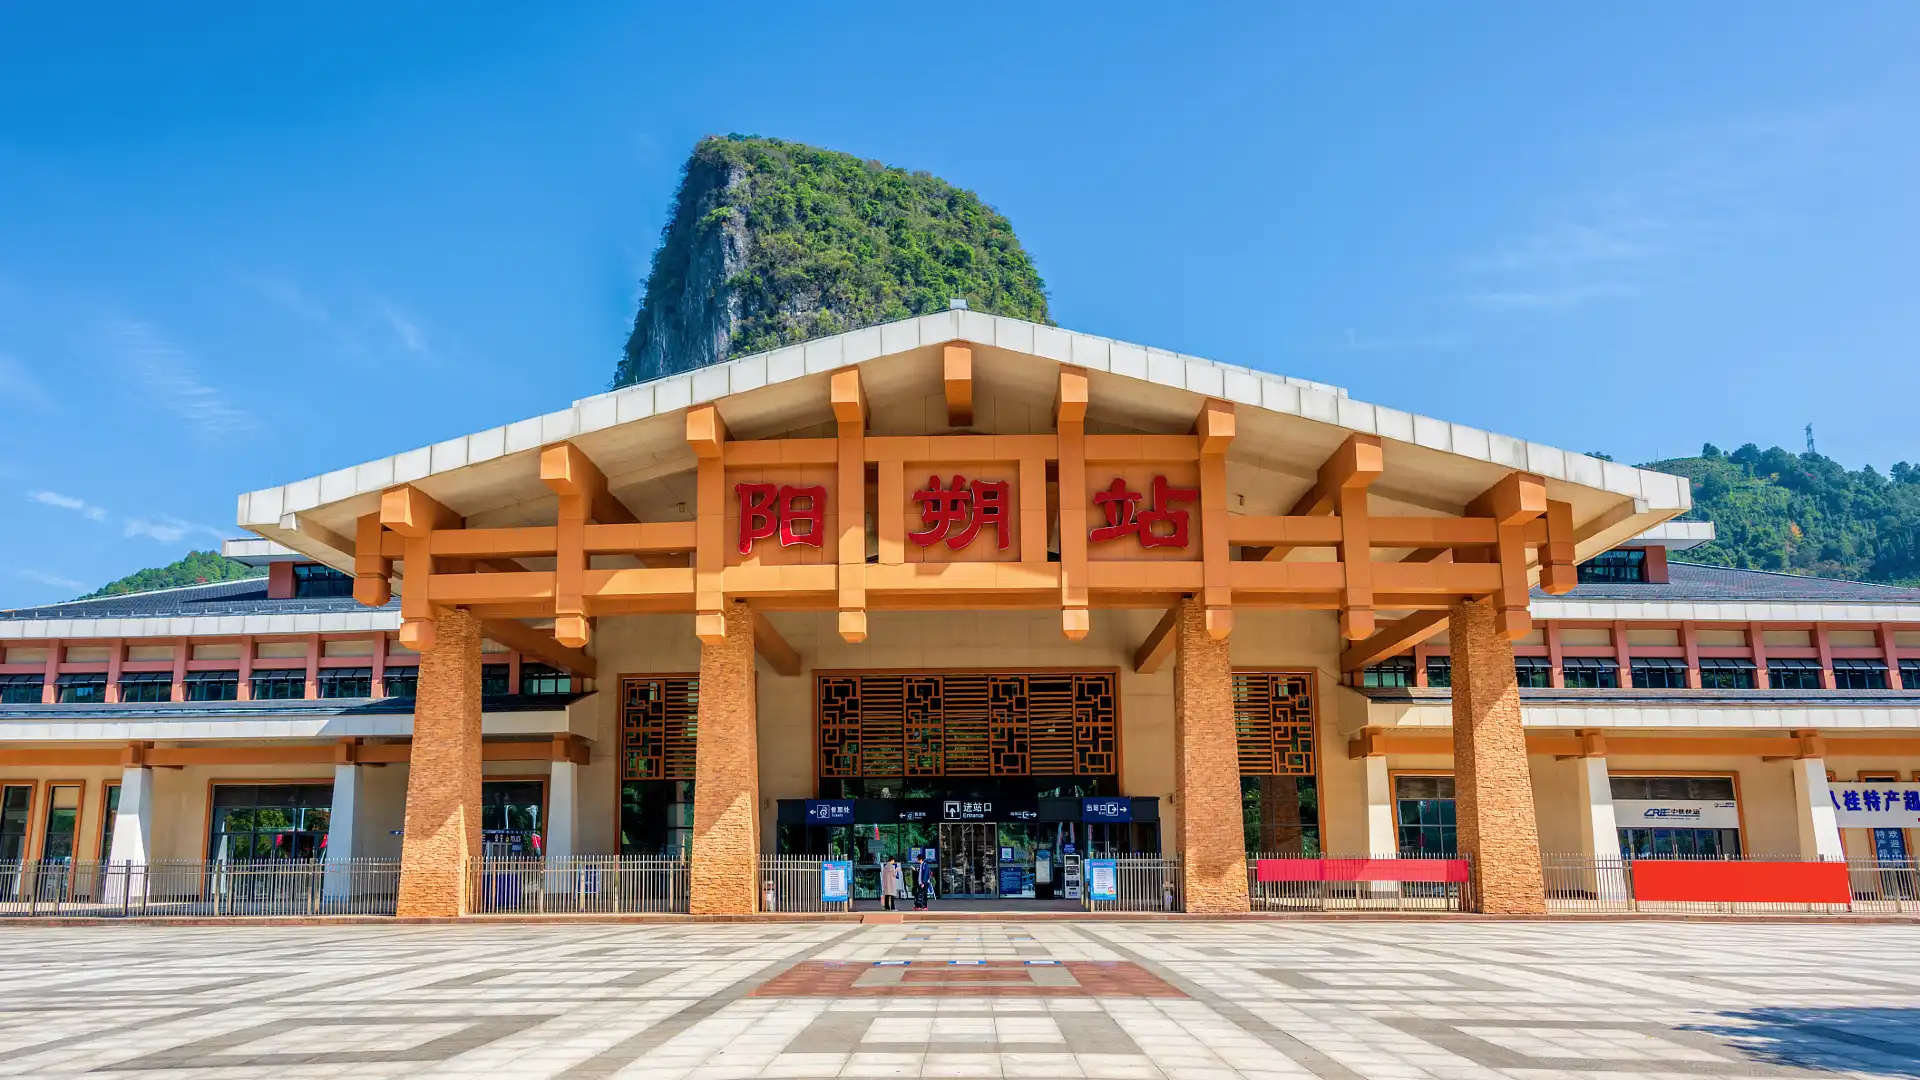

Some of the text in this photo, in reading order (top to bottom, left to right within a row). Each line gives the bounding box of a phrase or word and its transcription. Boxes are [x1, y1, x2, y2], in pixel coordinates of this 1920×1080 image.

[735, 475, 1199, 555] 阳朔站
[963, 802, 992, 813] 进站口
